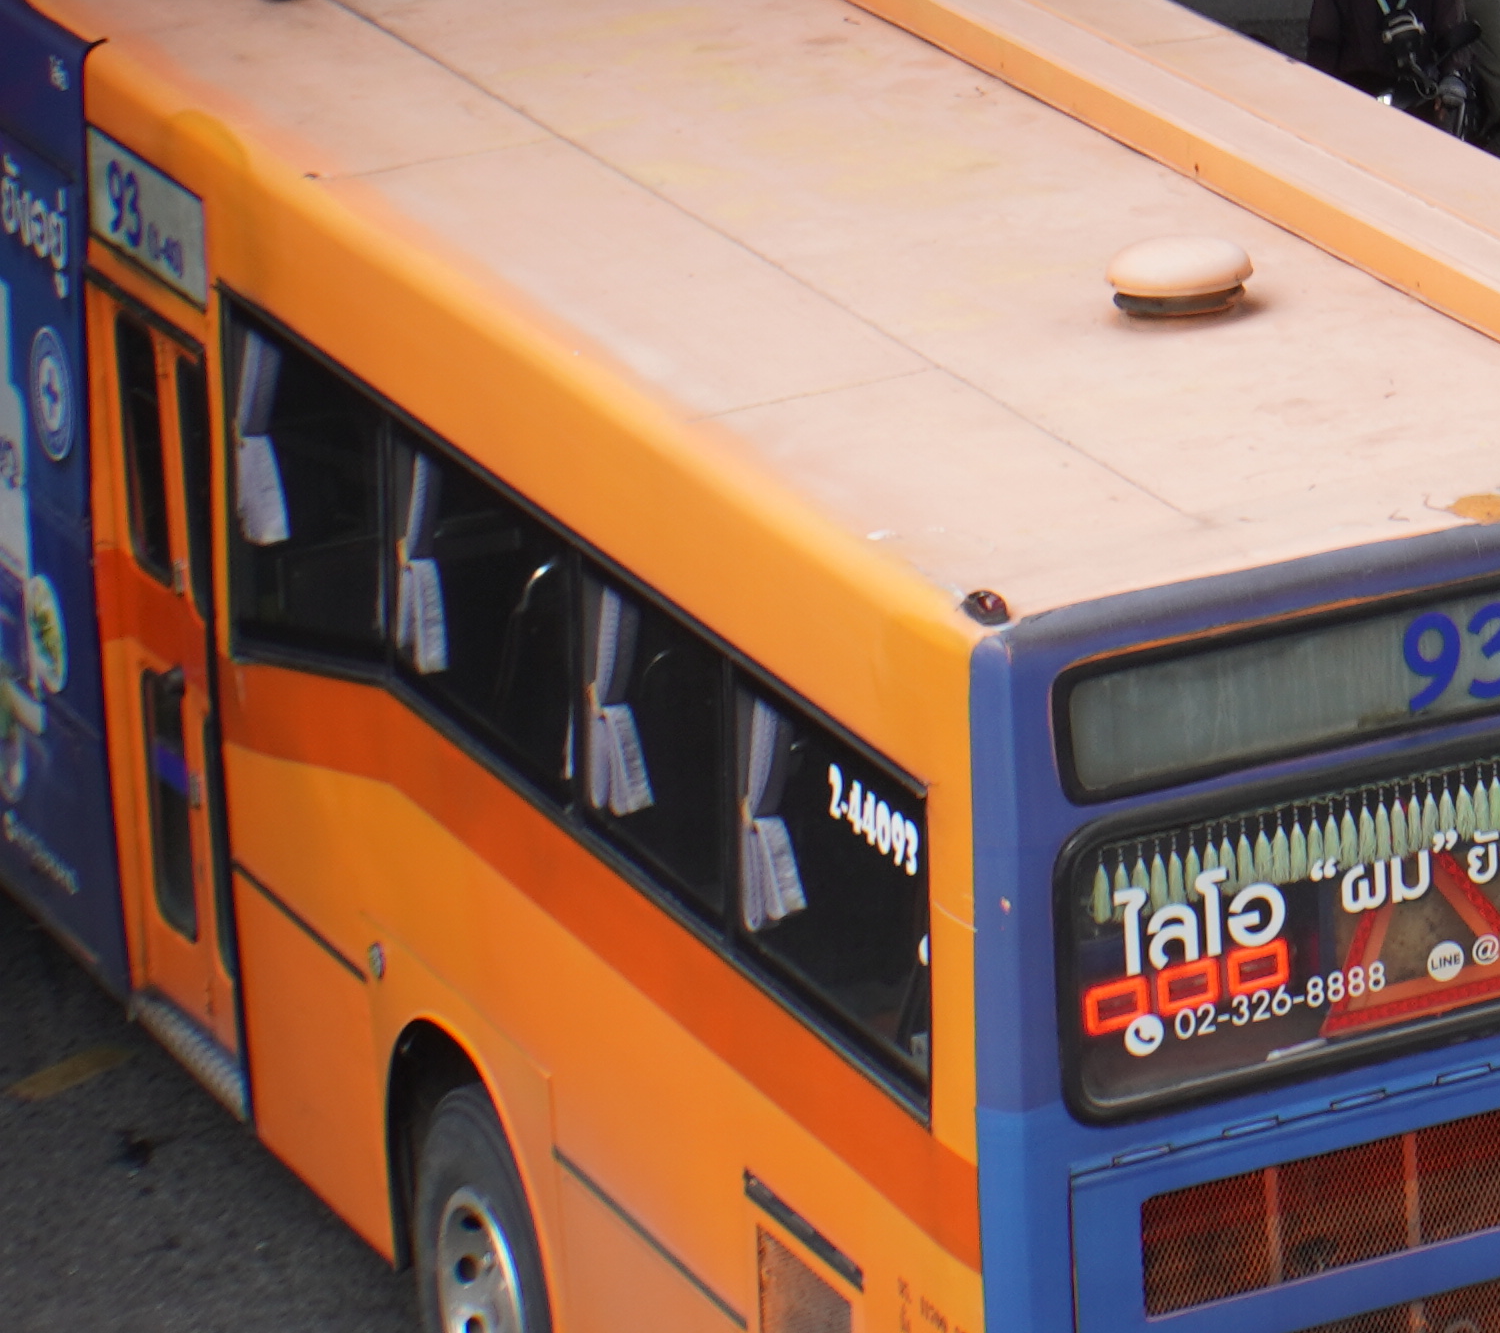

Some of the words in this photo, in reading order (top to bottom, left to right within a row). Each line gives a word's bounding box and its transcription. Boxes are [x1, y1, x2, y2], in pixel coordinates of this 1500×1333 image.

[106, 159, 143, 249] 93
[829, 763, 920, 876] 2-44093
[1113, 866, 1286, 977] ไลโอ
[1430, 952, 1462, 970] LINE
[1174, 961, 1387, 1040] 02-326-8888
